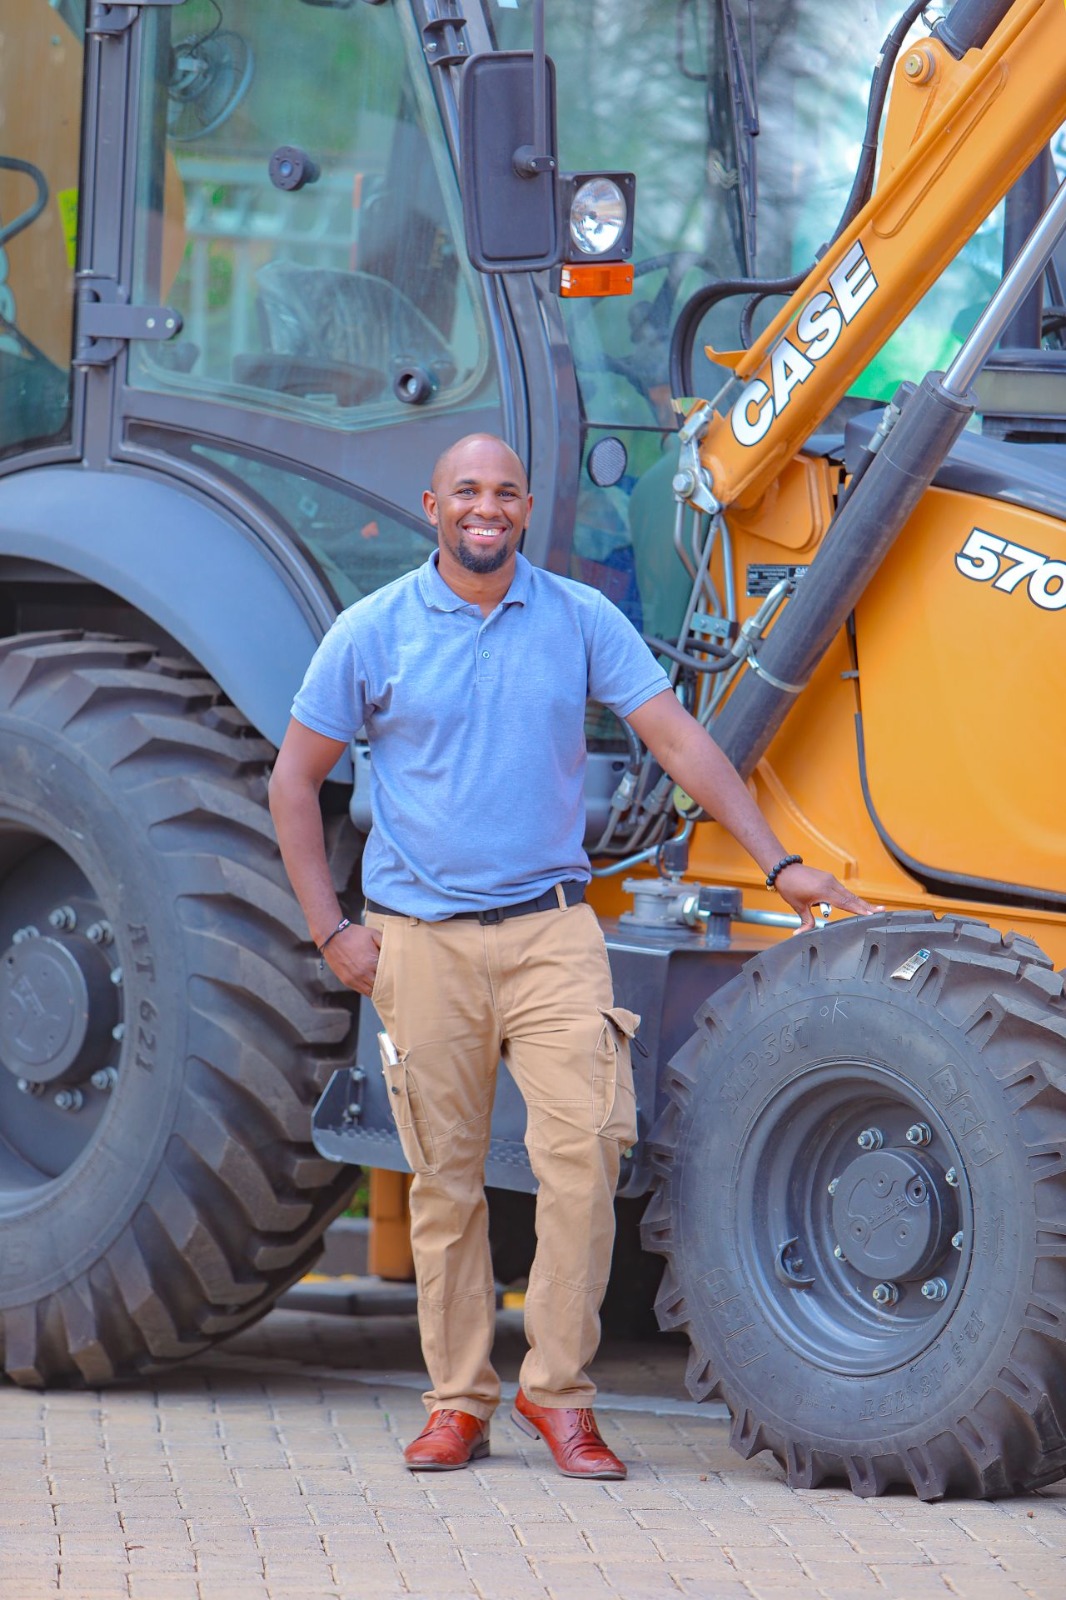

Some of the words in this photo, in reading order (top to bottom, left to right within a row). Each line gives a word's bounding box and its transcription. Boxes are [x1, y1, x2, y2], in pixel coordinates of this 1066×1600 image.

[731, 239, 878, 446] CASE
[954, 526, 1066, 611] 570
[930, 1066, 1001, 1163] BKT
